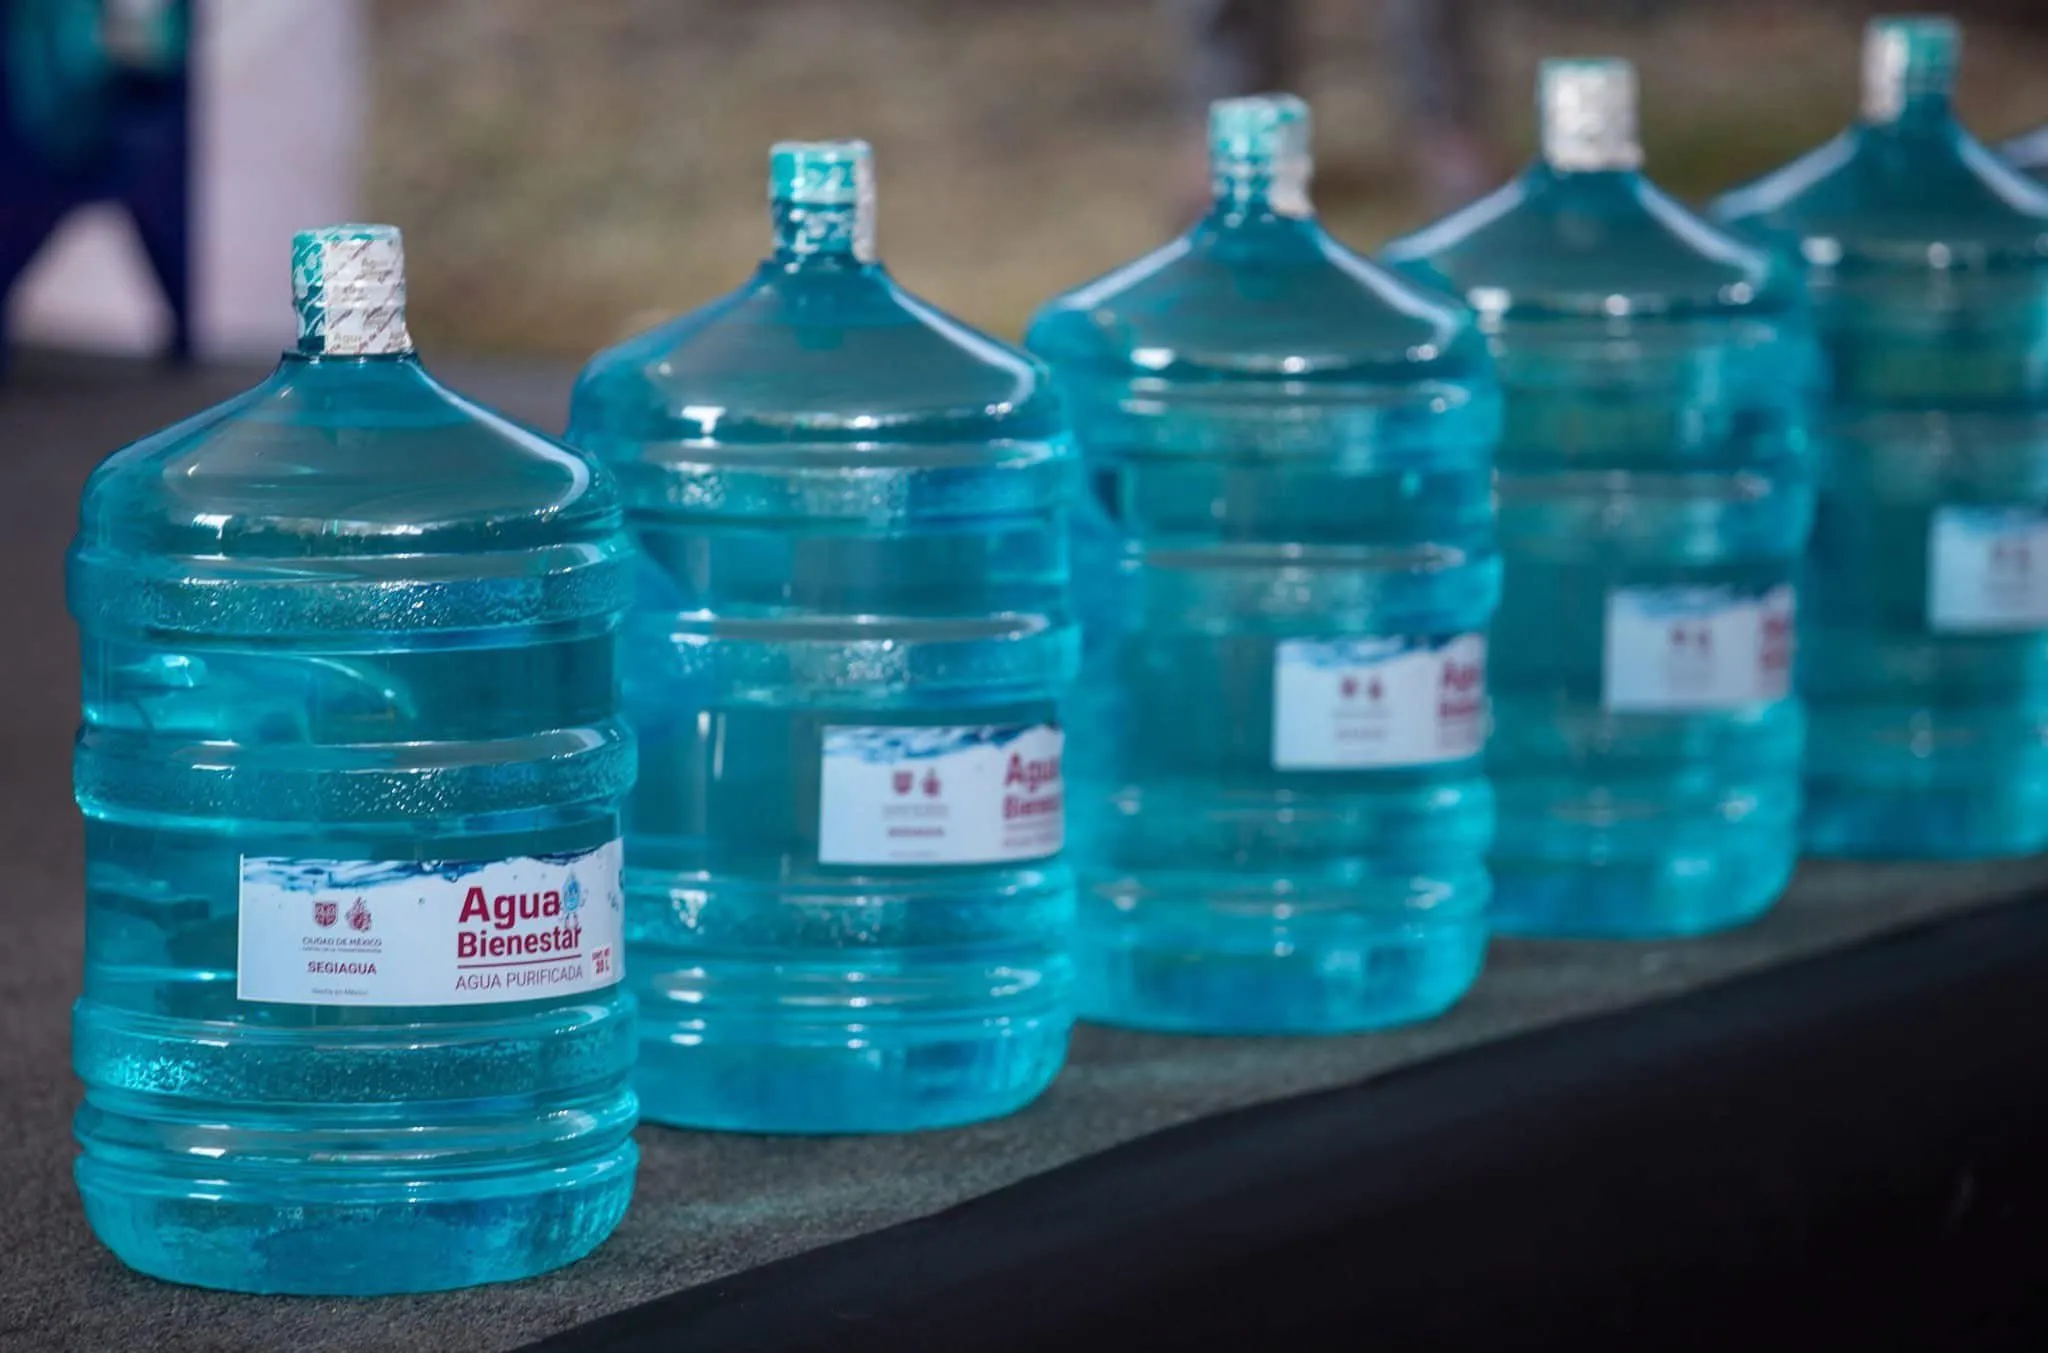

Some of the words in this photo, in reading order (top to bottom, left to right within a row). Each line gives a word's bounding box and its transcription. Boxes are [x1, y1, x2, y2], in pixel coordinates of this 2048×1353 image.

[458, 886, 561, 931] Agua
[302, 936, 334, 946] CIUDAD
[336, 937, 348, 947] DE
[456, 926, 583, 959] Bienestar
[308, 961, 376, 974] SEGIAGUA
[455, 973, 502, 991] AGUA
[507, 965, 584, 988] PURIFICADA
